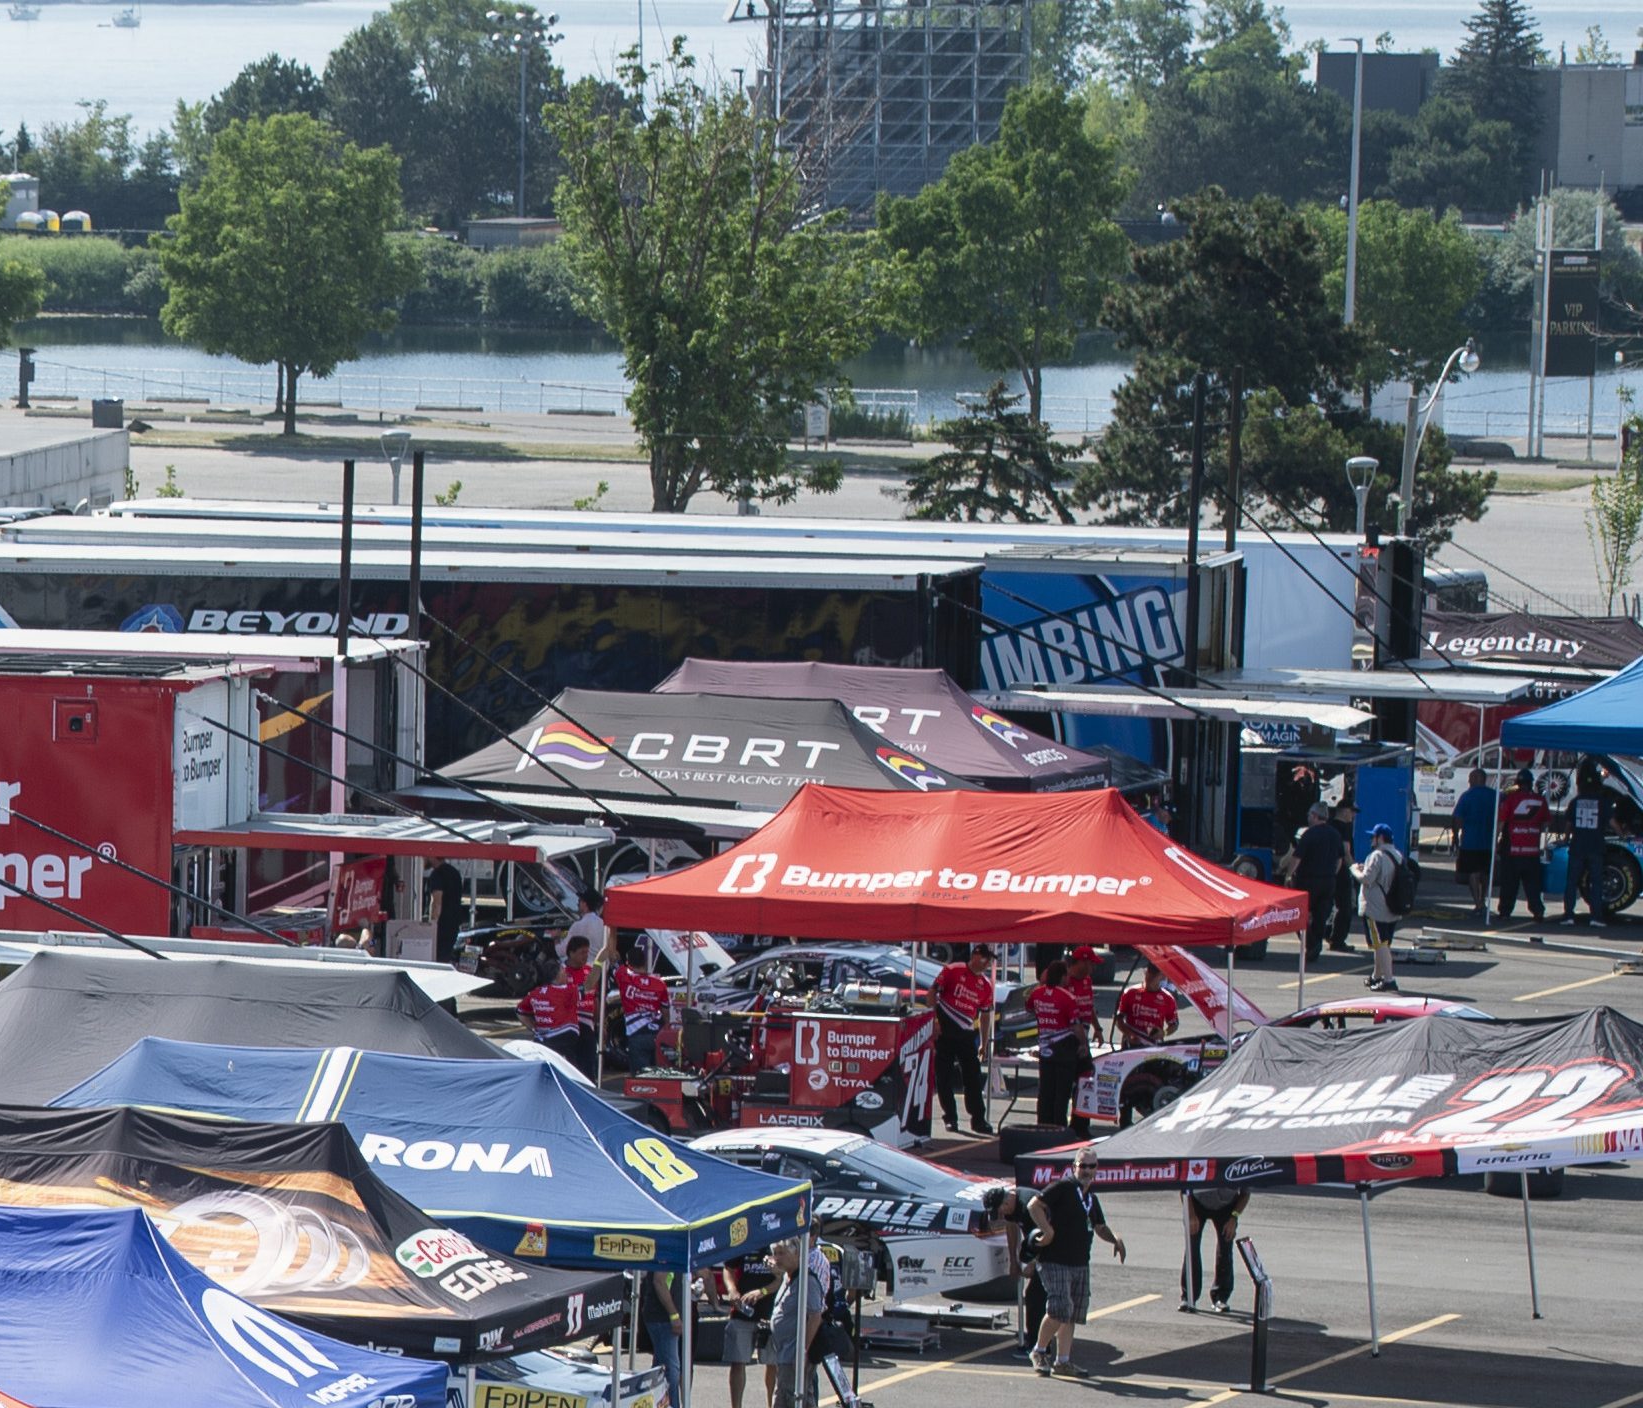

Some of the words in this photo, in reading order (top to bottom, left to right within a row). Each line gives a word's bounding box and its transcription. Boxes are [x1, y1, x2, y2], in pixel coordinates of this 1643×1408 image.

[188, 609, 411, 637] BEYOND
[1423, 632, 1586, 659] Legendary
[627, 732, 839, 770] CBRT
[693, 772, 726, 784] BEST
[727, 774, 782, 787] RACING
[781, 865, 933, 892] Bumper
[938, 867, 978, 890] to
[827, 1030, 876, 1047] Bumper
[827, 1047, 840, 1058] to
[841, 1046, 891, 1062] Bumper
[832, 1077, 874, 1089] TOTAL
[1417, 1063, 1625, 1134] 22
[759, 1113, 825, 1128] LACROIX
[1277, 1109, 1413, 1129] CANADA
[359, 1133, 553, 1178] RONA
[624, 1138, 698, 1194] 18
[1476, 1151, 1552, 1166] RACING
[1092, 1162, 1176, 1182] amirand
[816, 1197, 944, 1227] PAILLE
[943, 1256, 975, 1268] ECC
[439, 1259, 529, 1301] EDGE
[307, 1373, 377, 1406] MOPAR
